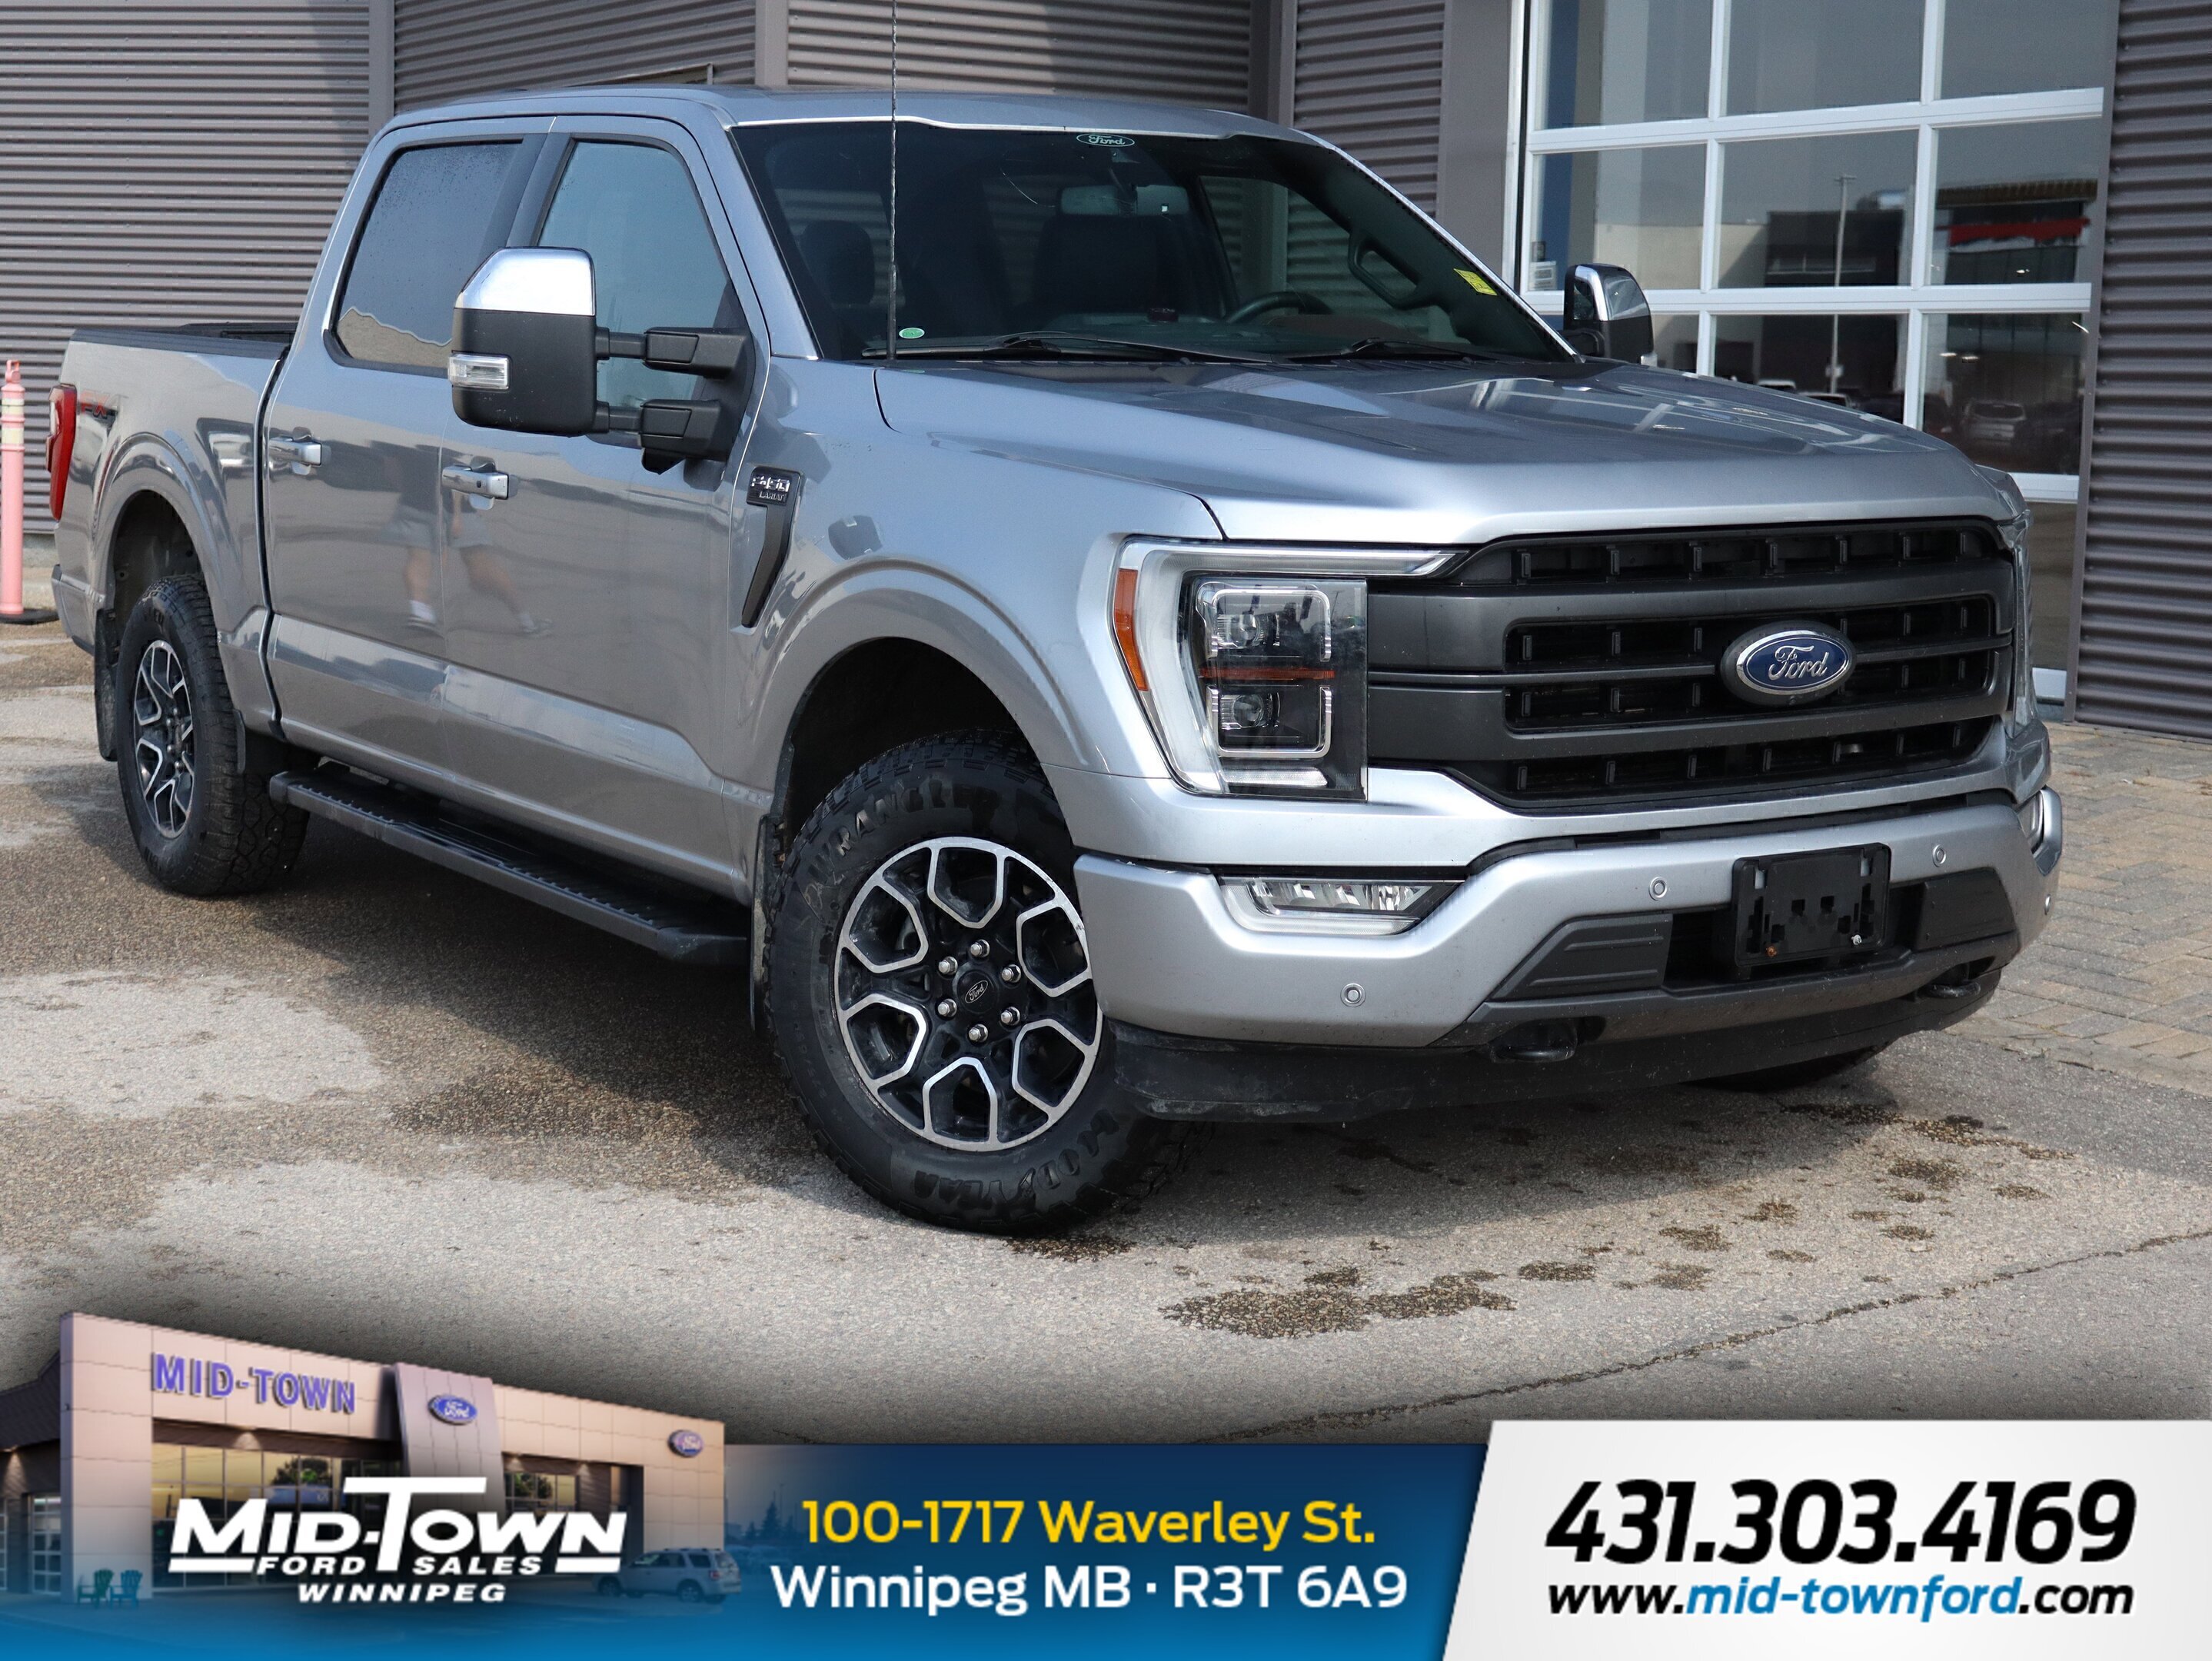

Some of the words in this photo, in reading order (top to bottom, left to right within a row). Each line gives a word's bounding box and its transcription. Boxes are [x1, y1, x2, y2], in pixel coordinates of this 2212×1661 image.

[1088, 135, 1126, 145] Ford
[1768, 644, 1830, 681] Ford
[968, 983, 985, 1001] Ford
